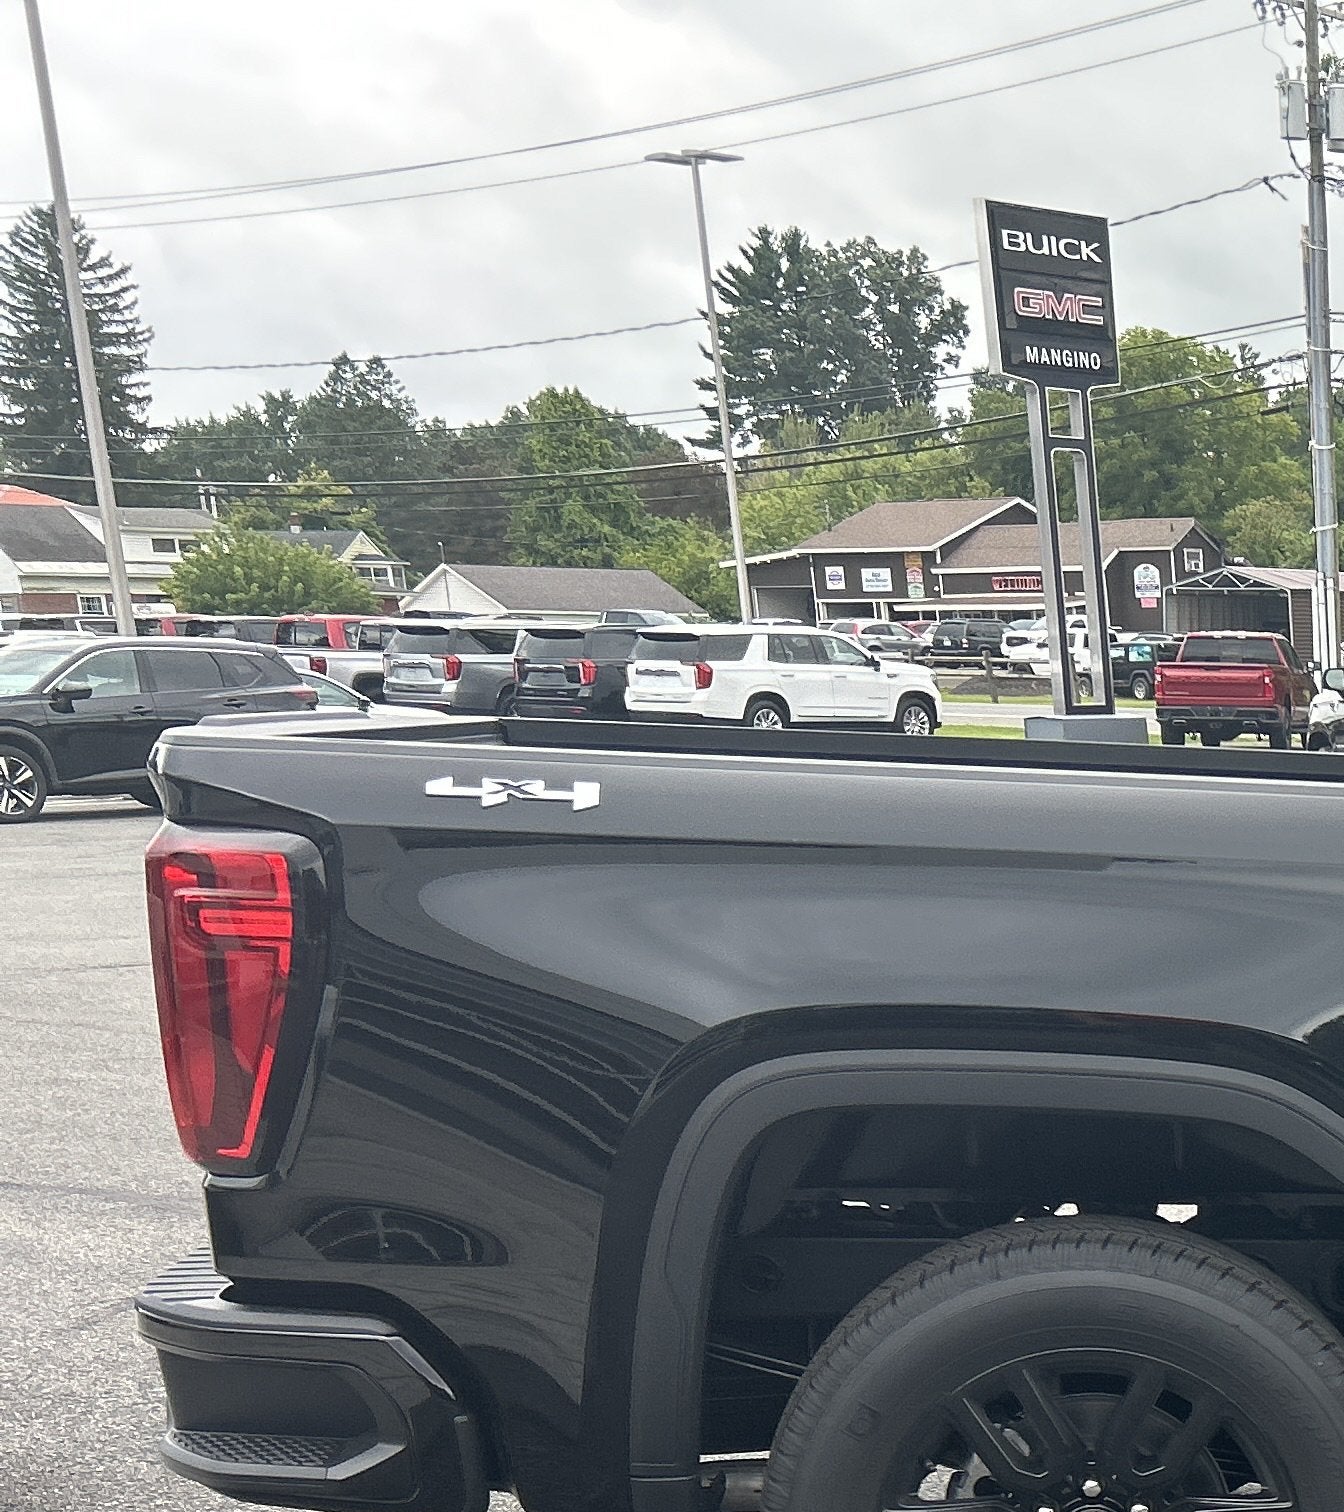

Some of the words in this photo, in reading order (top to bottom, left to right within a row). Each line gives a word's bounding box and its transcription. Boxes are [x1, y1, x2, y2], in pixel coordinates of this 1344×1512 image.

[1001, 229, 1104, 264] BUICK
[1013, 287, 1104, 326] GMC
[1025, 345, 1101, 371] MANGINO
